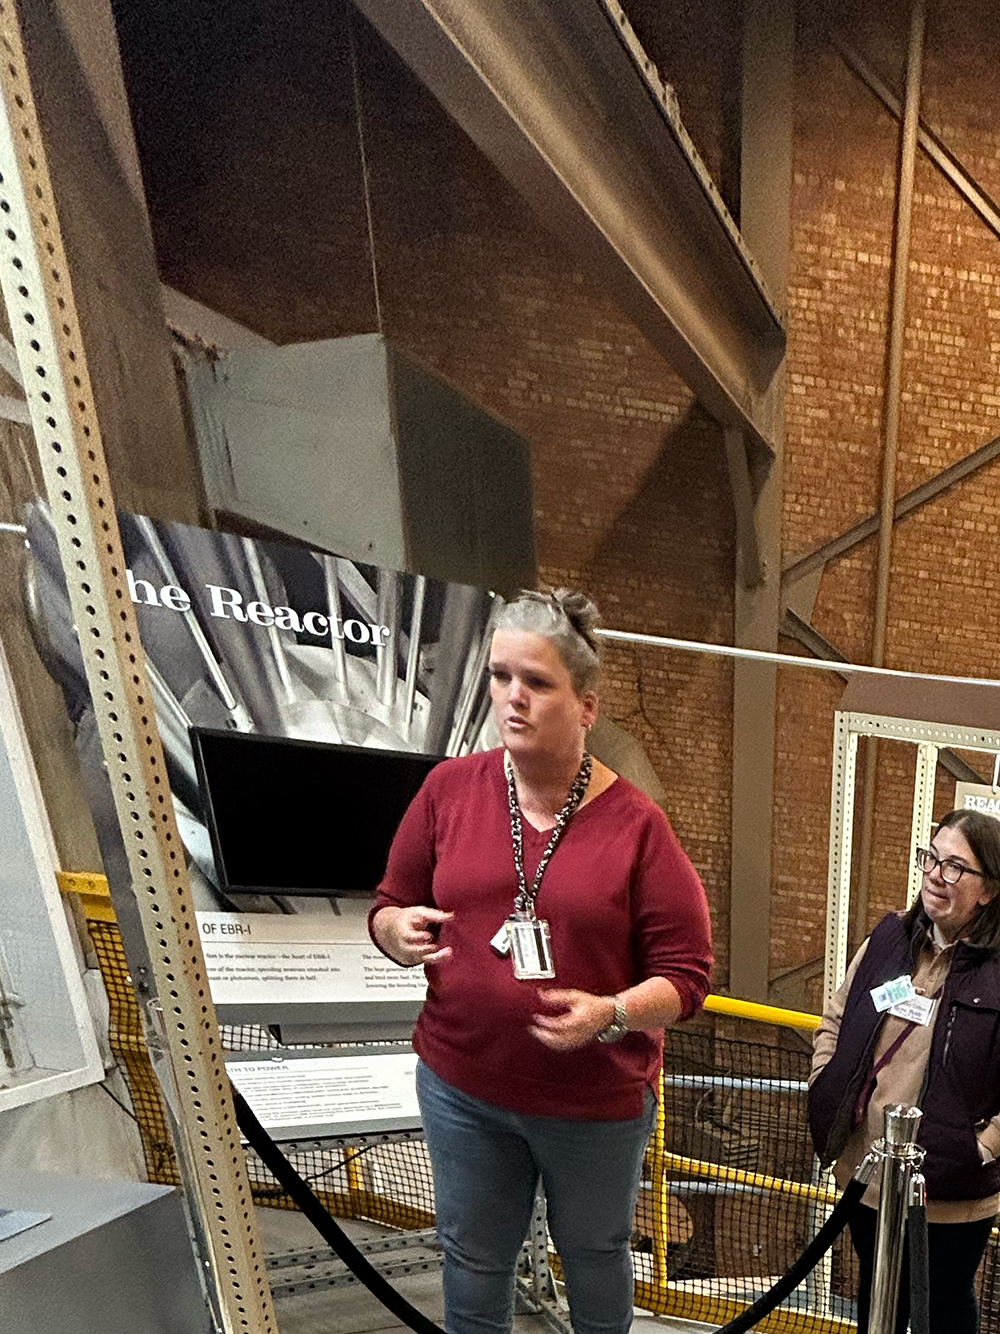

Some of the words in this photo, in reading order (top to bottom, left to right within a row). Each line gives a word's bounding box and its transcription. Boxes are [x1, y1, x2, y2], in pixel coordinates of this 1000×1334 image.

[126, 569, 191, 612] he
[205, 584, 391, 646] Reactor
[202, 923, 217, 935] OF
[220, 923, 252, 936] EBR-I
